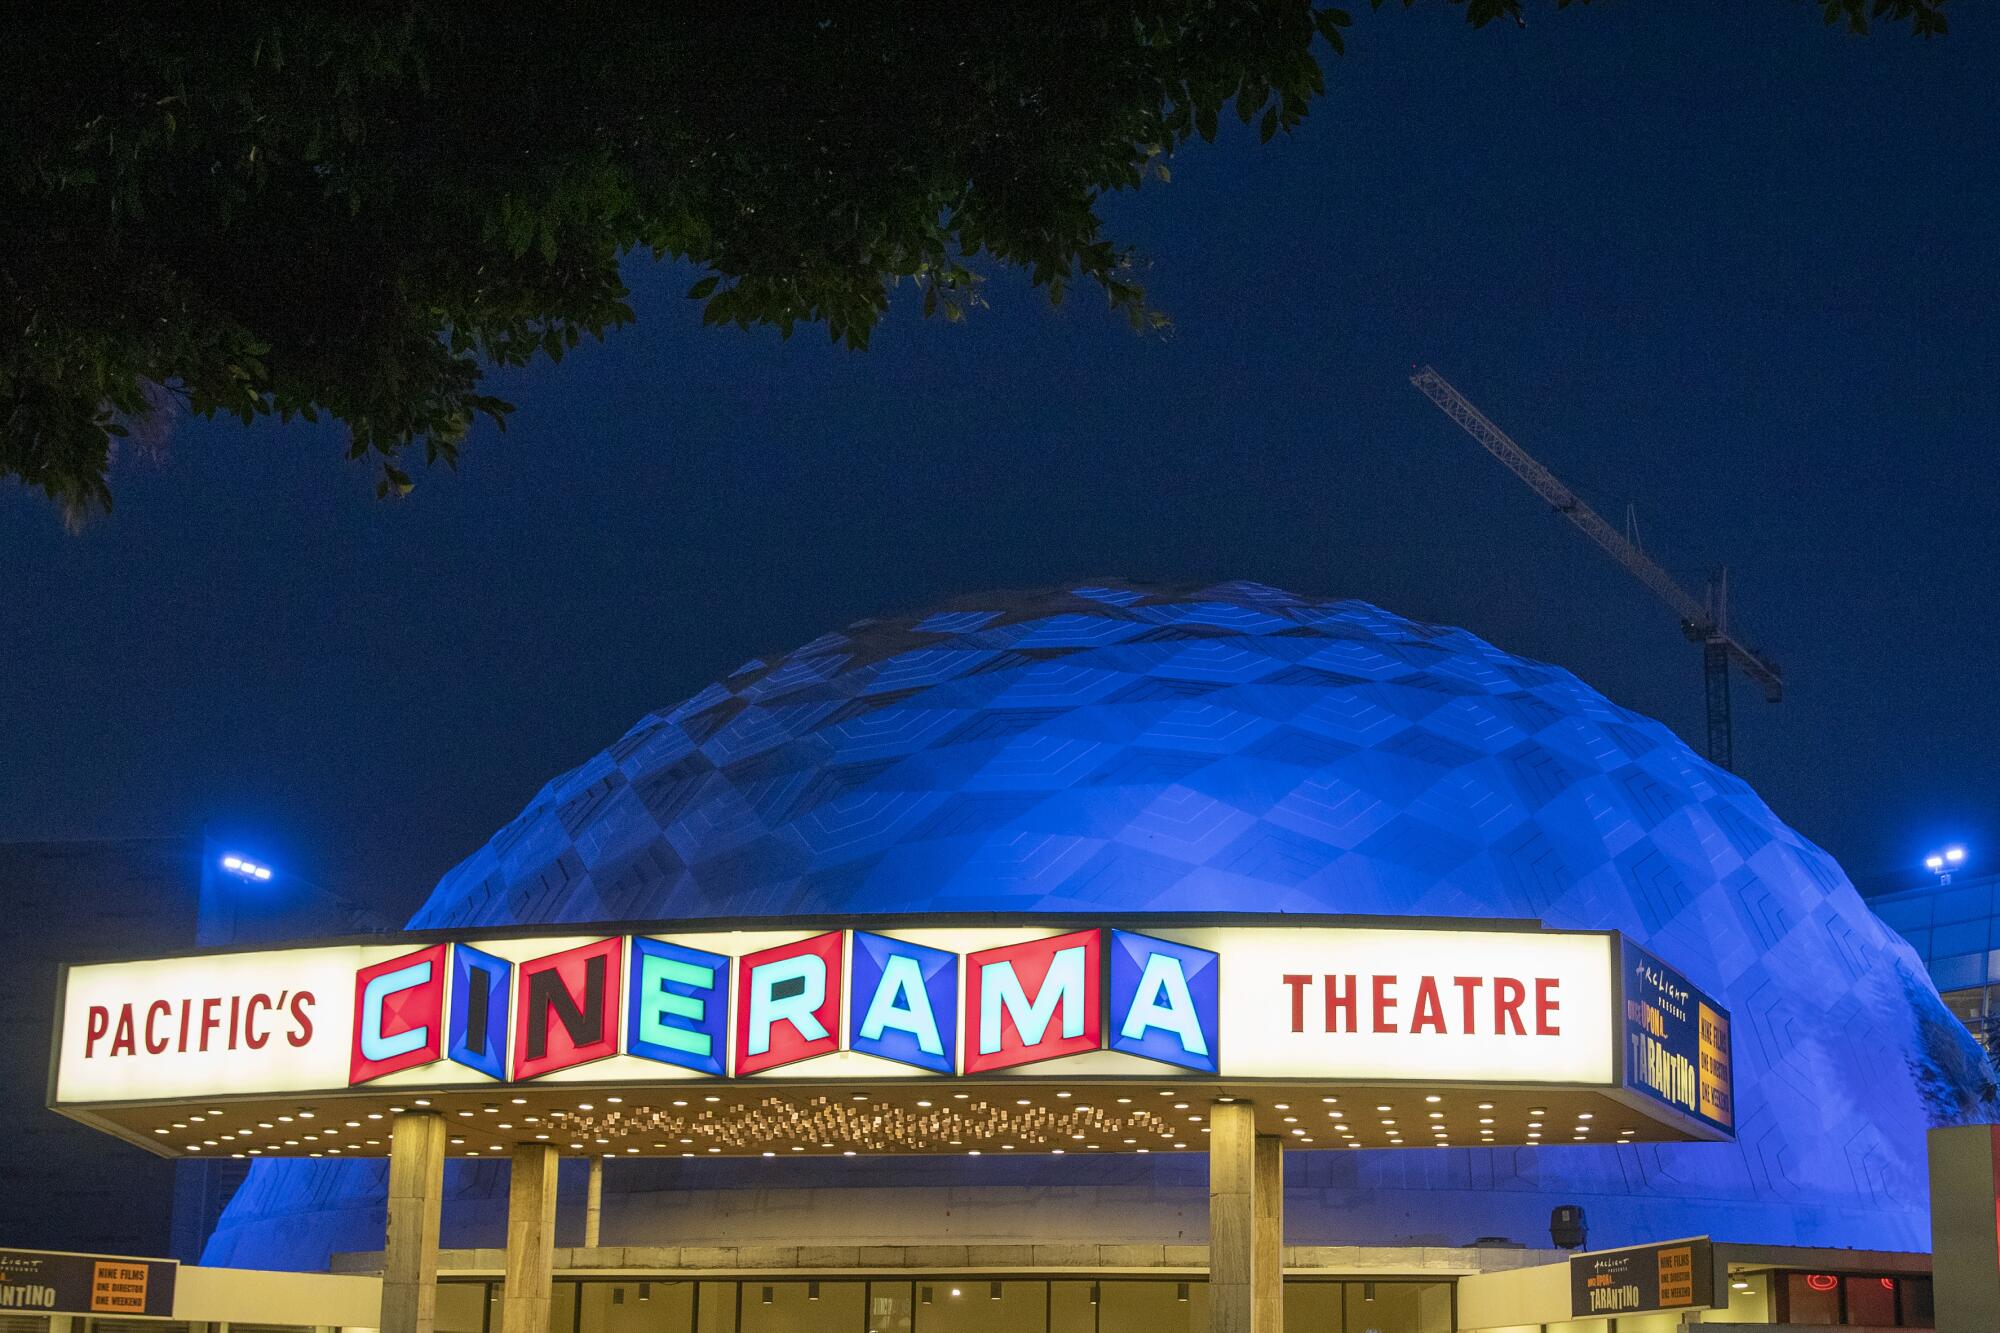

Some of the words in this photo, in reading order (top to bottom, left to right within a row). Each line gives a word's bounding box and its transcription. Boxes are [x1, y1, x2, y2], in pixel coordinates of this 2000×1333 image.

[84, 989, 317, 1058] PACIFIC'S
[359, 945, 1210, 1061] CINERAMA
[1282, 973, 1561, 1037] THEATRE
[1658, 996, 1686, 1022] PRESENTS
[1641, 1000, 1660, 1037] UPON
[1701, 1017, 1712, 1045] NINE
[1713, 1025, 1728, 1054] FILMS
[1631, 1033, 1696, 1111] TARANTINO
[1701, 1051, 1709, 1072] ONE
[1701, 1081, 1710, 1103] ONE
[1661, 1256, 1673, 1268] NINE
[1674, 1254, 1689, 1267] FILMS
[98, 1267, 118, 1279] NINE
[120, 1269, 145, 1280] FILMS
[1661, 1274, 1669, 1283] ONE
[96, 1283, 110, 1291] ONE
[112, 1283, 144, 1293] DIRECTOR
[1589, 1285, 1639, 1312] TARANTINO
[1661, 1288, 1670, 1299] ONE
[95, 1296, 109, 1305] ONE
[112, 1297, 143, 1307] WEEKEND
